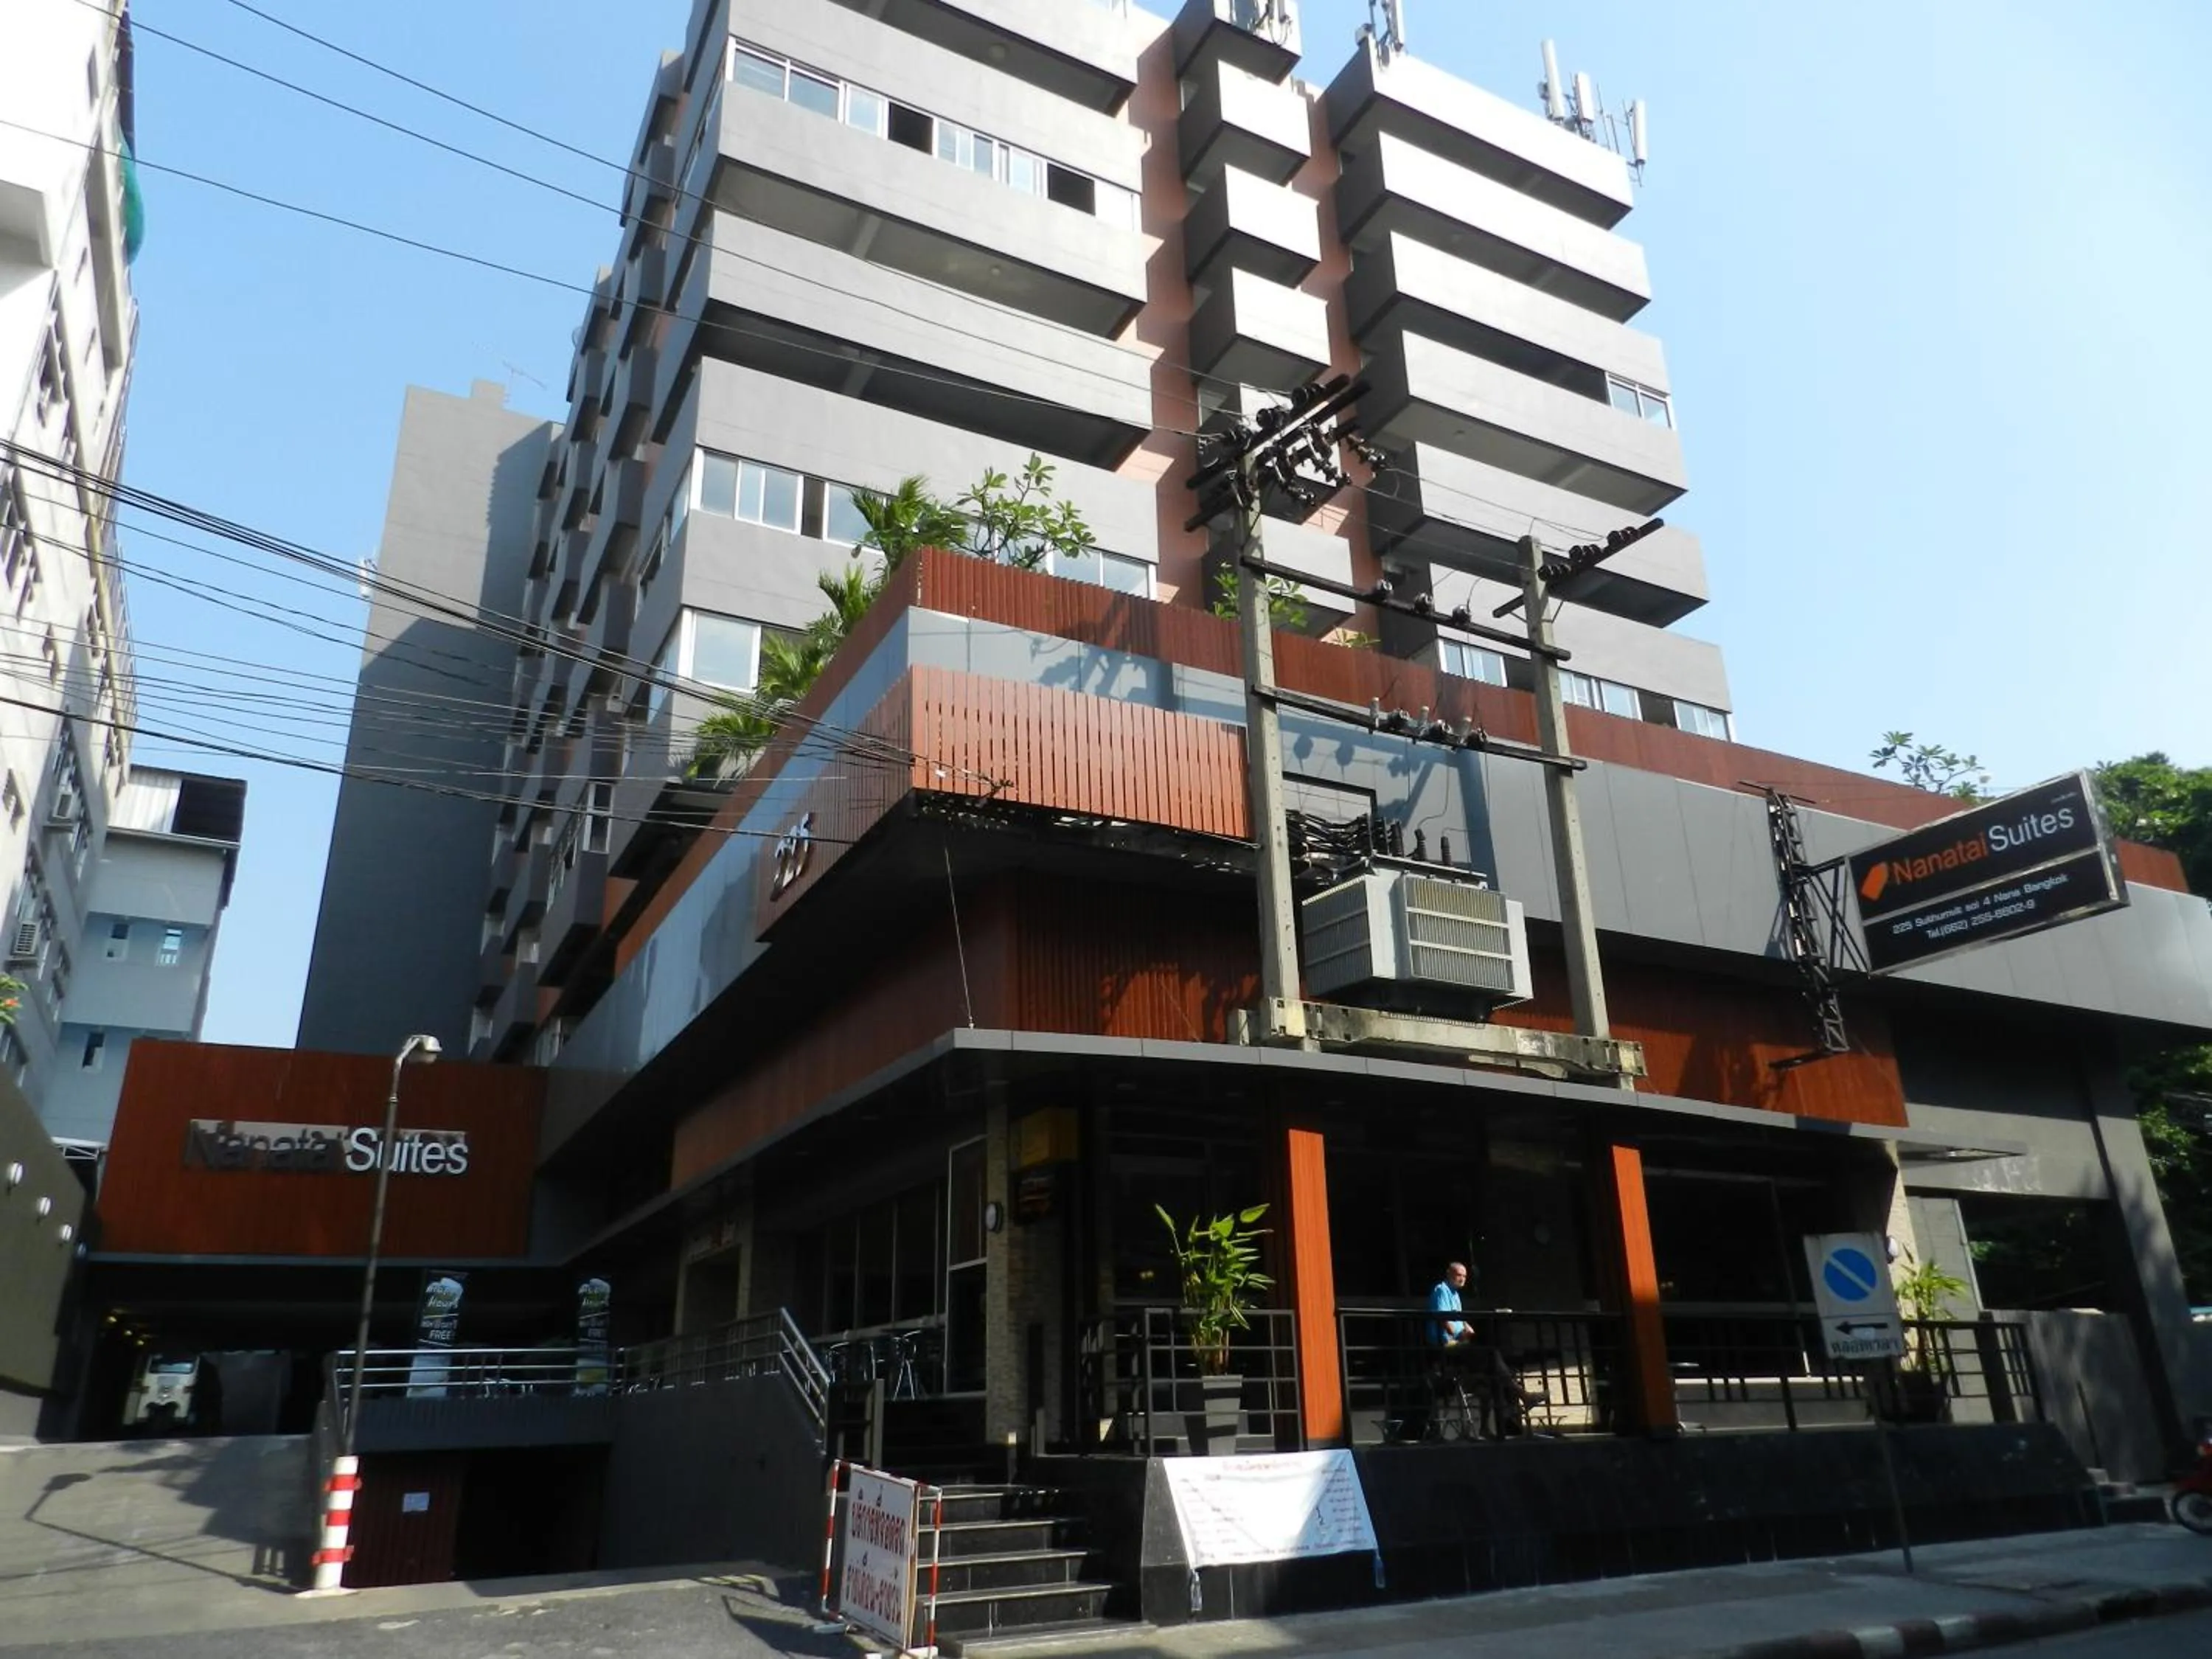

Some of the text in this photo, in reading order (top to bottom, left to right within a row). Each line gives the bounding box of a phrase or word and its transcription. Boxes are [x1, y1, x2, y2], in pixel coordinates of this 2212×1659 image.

[1892, 807, 2075, 886] Nanatai Suites
[1983, 896, 1991, 906] 4
[2023, 874, 2068, 894] Bangkok
[345, 1127, 469, 1175] Suites
